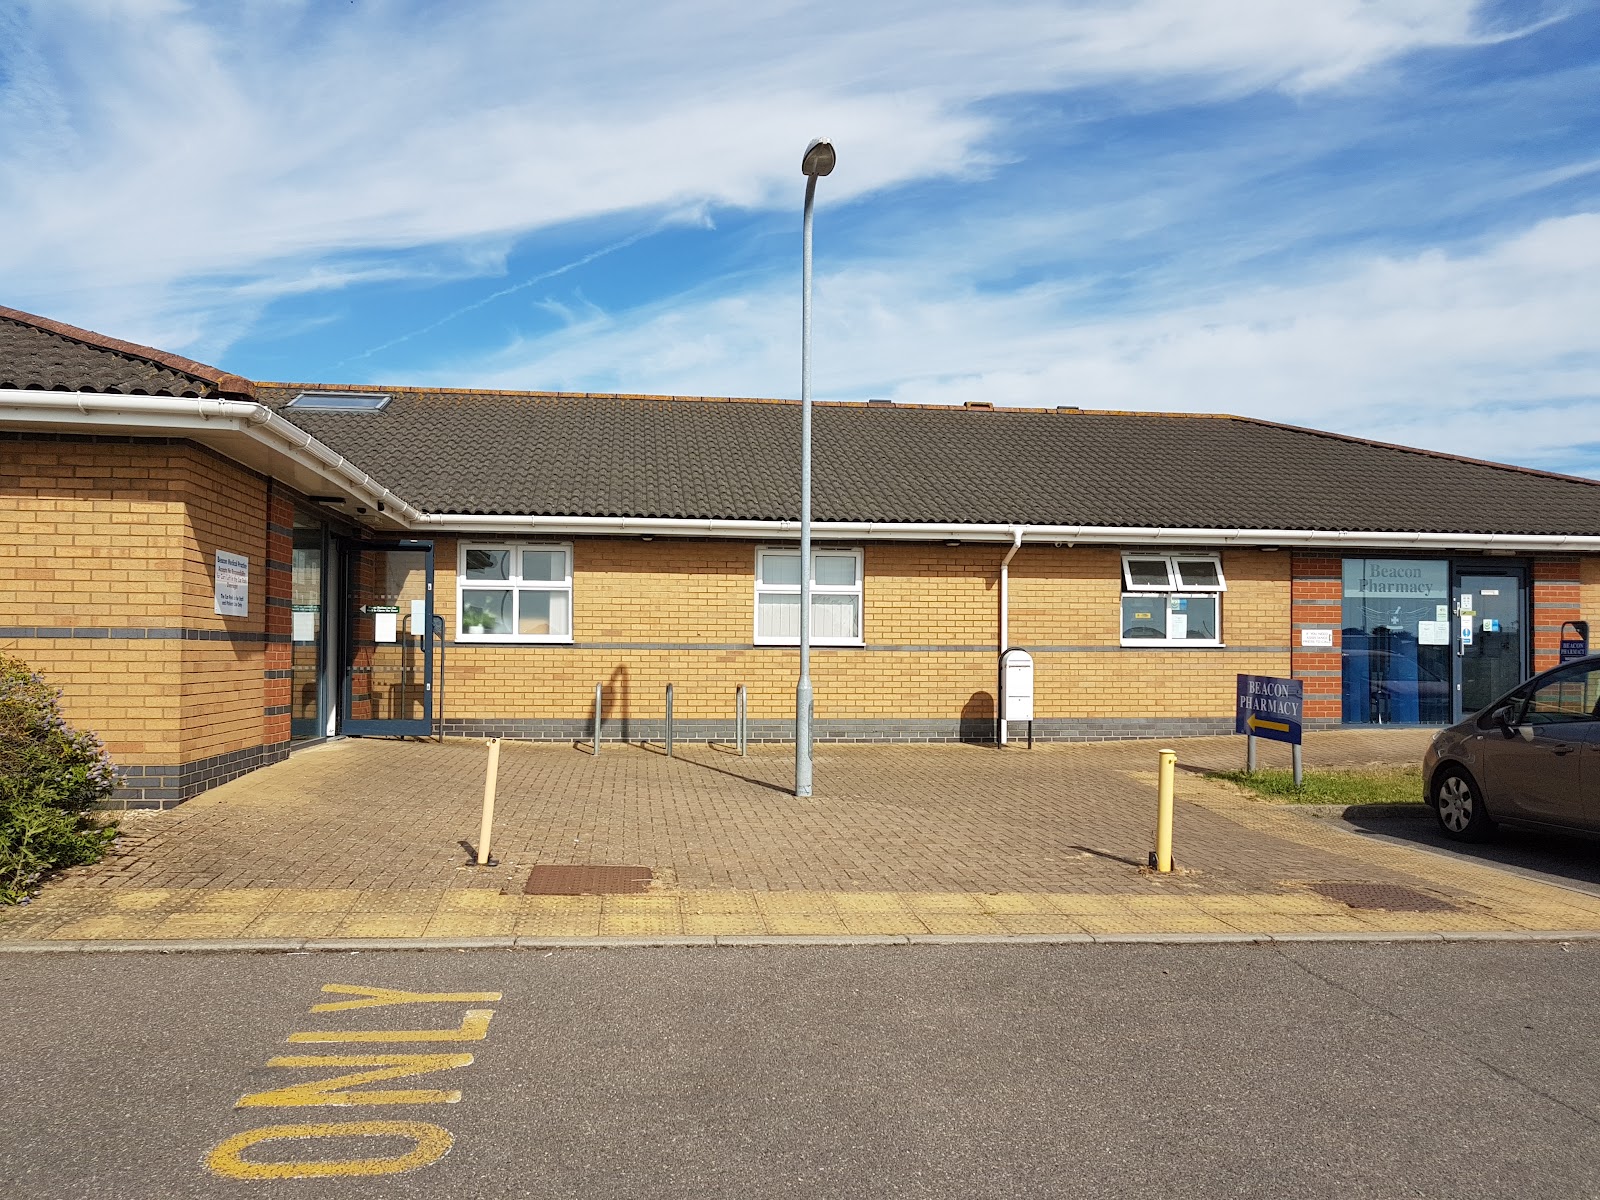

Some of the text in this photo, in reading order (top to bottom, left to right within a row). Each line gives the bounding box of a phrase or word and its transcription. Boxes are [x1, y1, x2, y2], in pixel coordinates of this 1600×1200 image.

[1369, 563, 1421, 578] Beacon
[1358, 579, 1433, 597] Pharmacy
[1249, 680, 1289, 699] BEACON
[1240, 695, 1299, 716] PHARMACY
[202, 983, 502, 1181] ONLY
